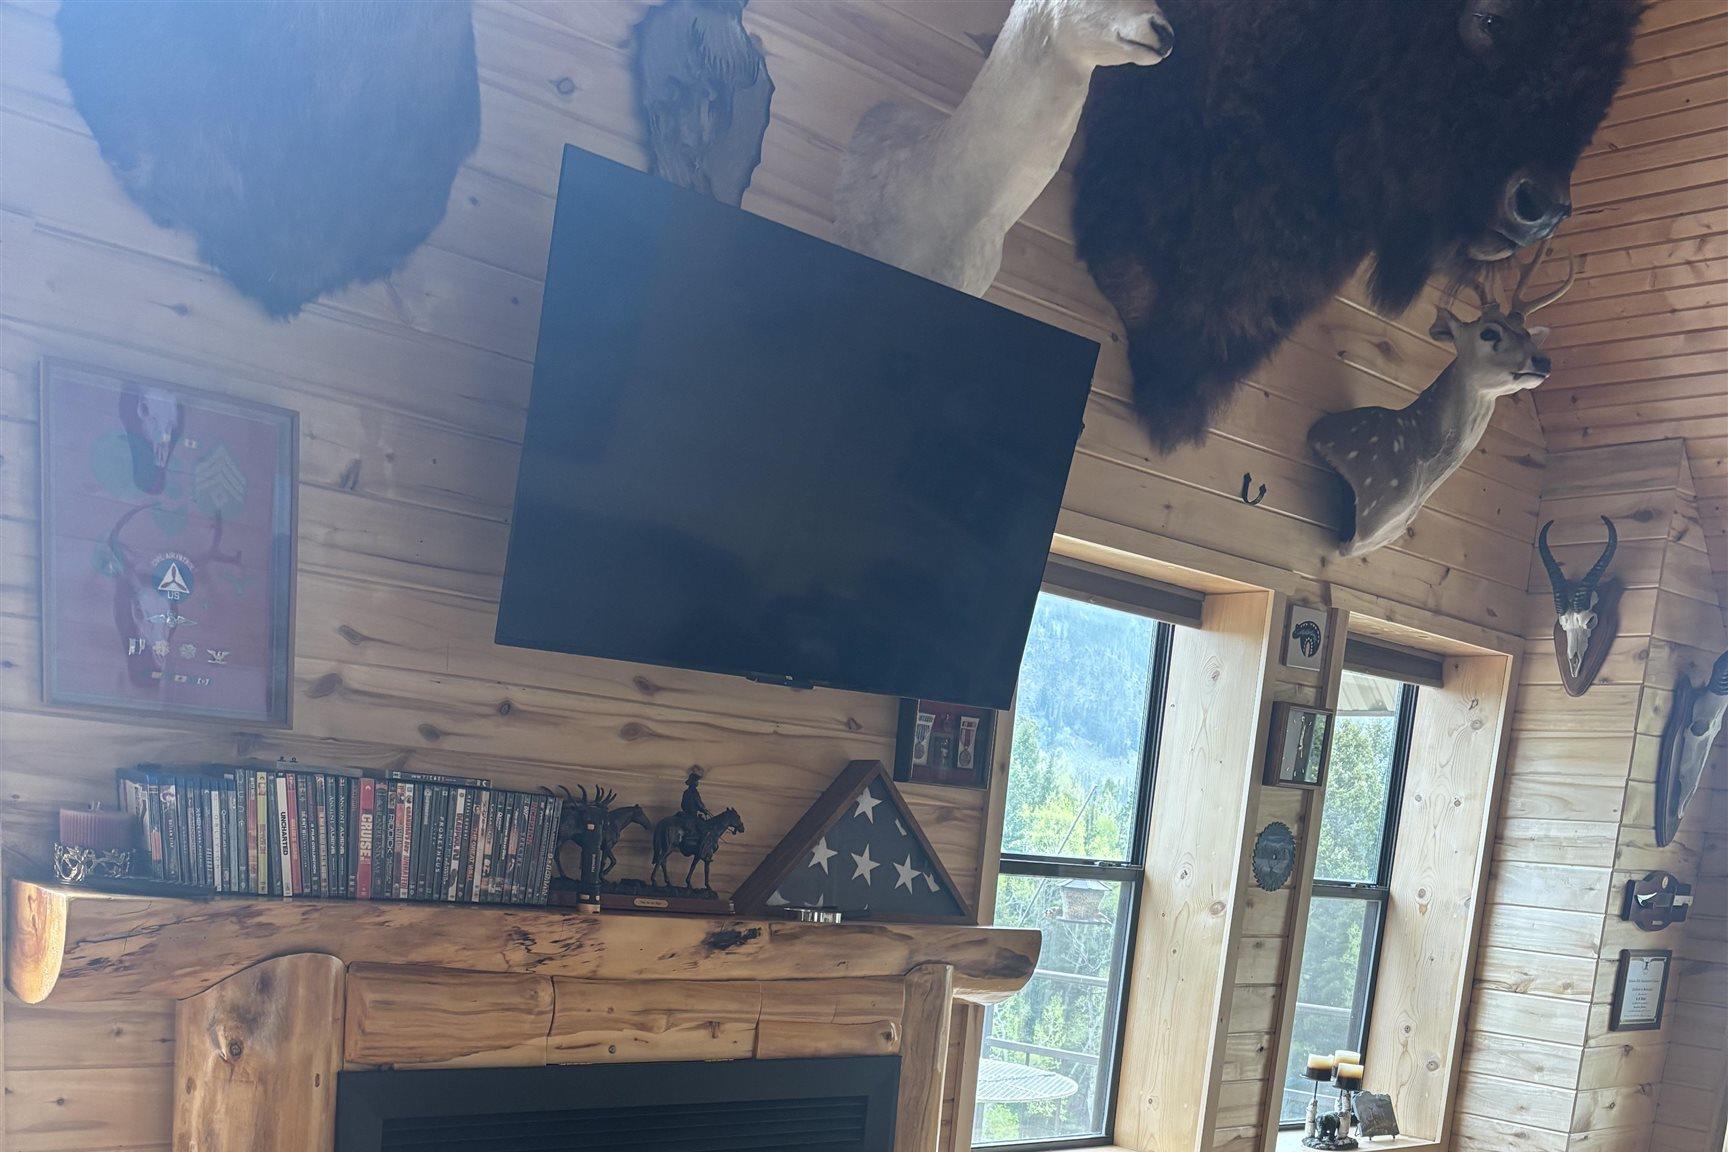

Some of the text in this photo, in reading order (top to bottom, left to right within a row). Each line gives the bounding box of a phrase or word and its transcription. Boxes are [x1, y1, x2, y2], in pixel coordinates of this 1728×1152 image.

[167, 591, 180, 600] US
[281, 811, 289, 856] UNCHARTED
[360, 813, 373, 857] CRUISE
[386, 813, 395, 855] RIDDICK
[435, 816, 445, 873] PROMETHEUS
